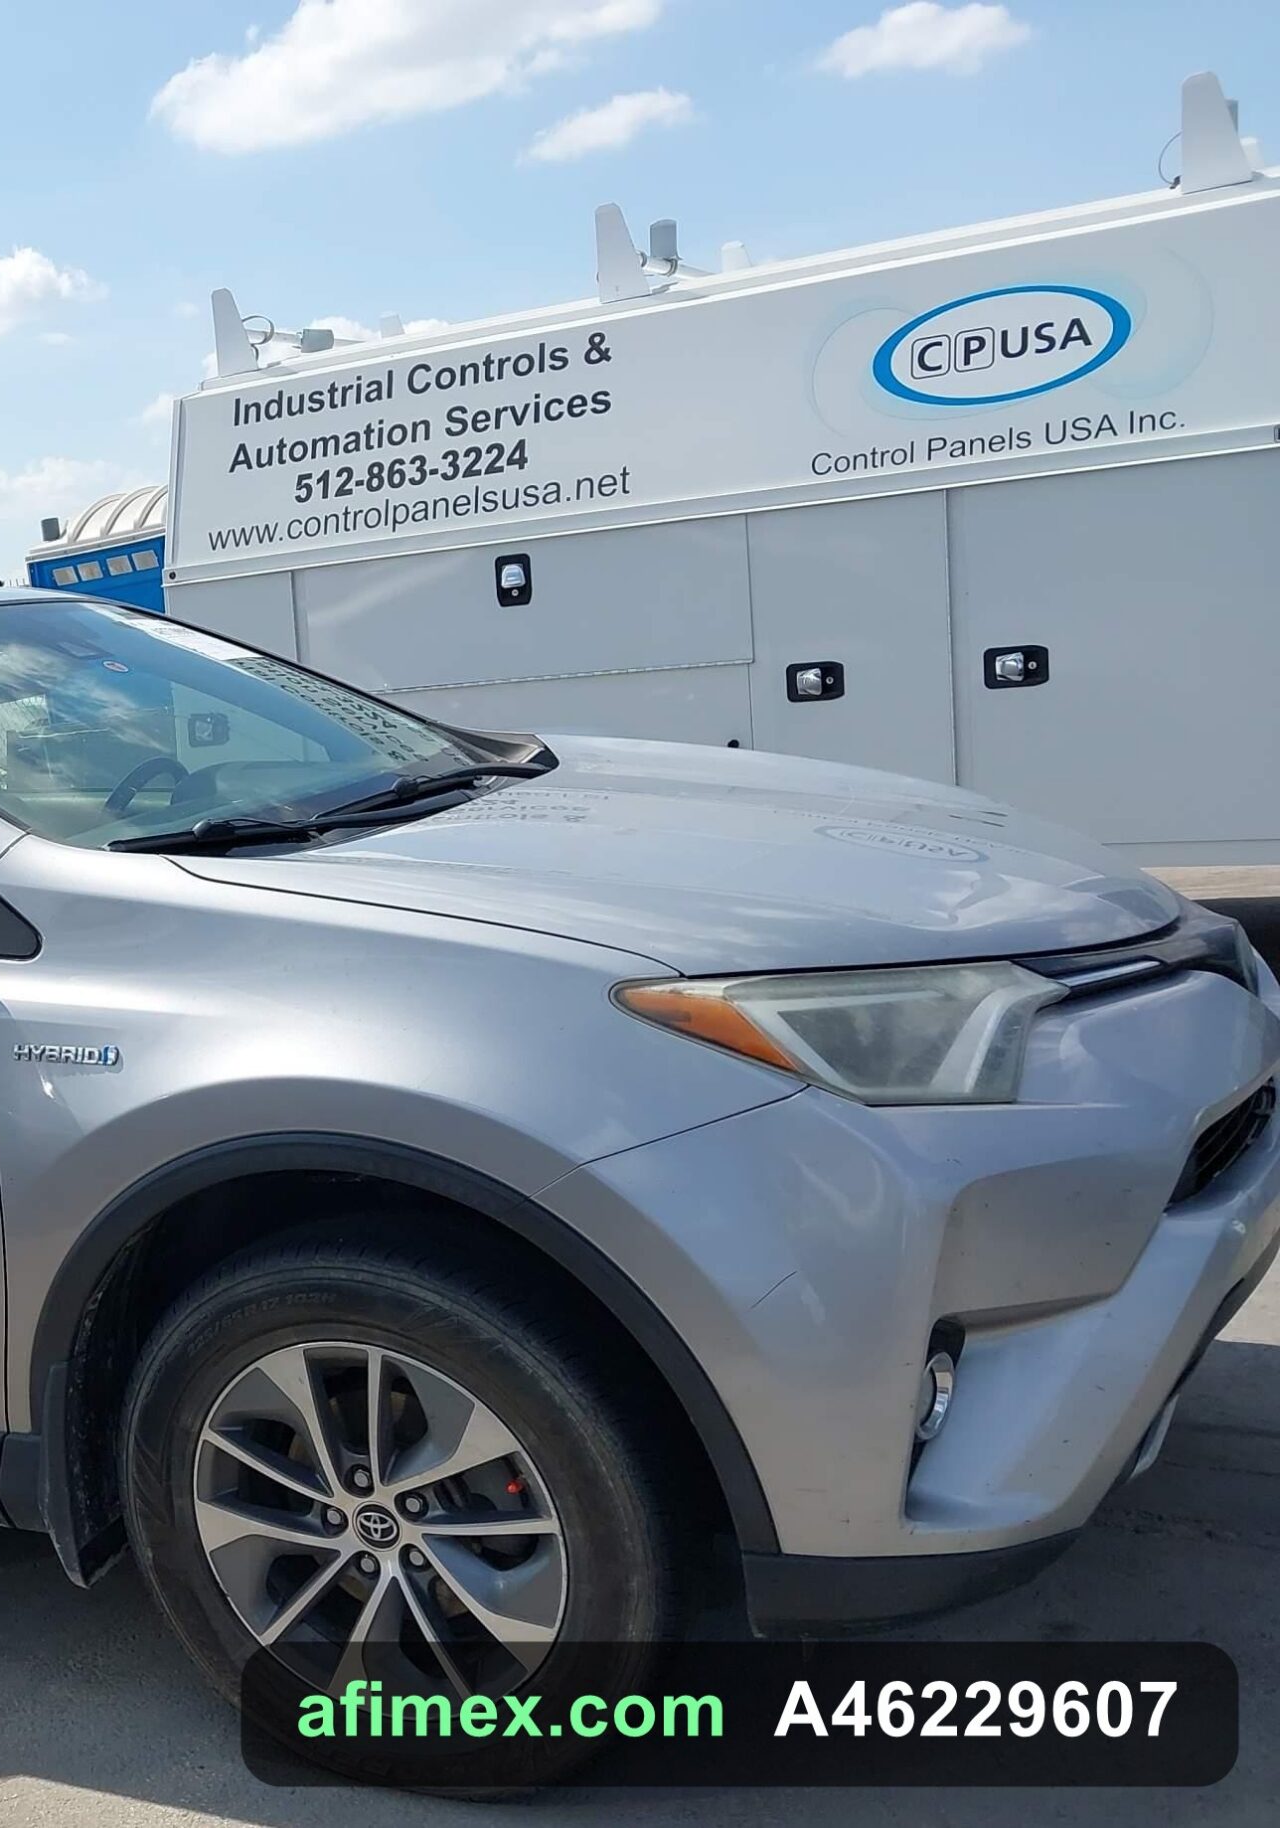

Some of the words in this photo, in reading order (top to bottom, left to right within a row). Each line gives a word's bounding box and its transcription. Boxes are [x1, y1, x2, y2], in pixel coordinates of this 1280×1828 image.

[232, 369, 395, 428] Industrial
[406, 342, 570, 396] Controls
[584, 331, 613, 366] &
[228, 418, 431, 473] Automation
[444, 389, 612, 437] Services
[810, 440, 916, 477] Control
[926, 427, 1033, 462] Panels
[1044, 413, 1118, 446] USA
[1128, 410, 1186, 435] Inc.
[294, 438, 529, 503] 512-863-3224
[207, 465, 631, 552] www.controlpanelsusa.net
[13, 1043, 100, 1066] HYBRID
